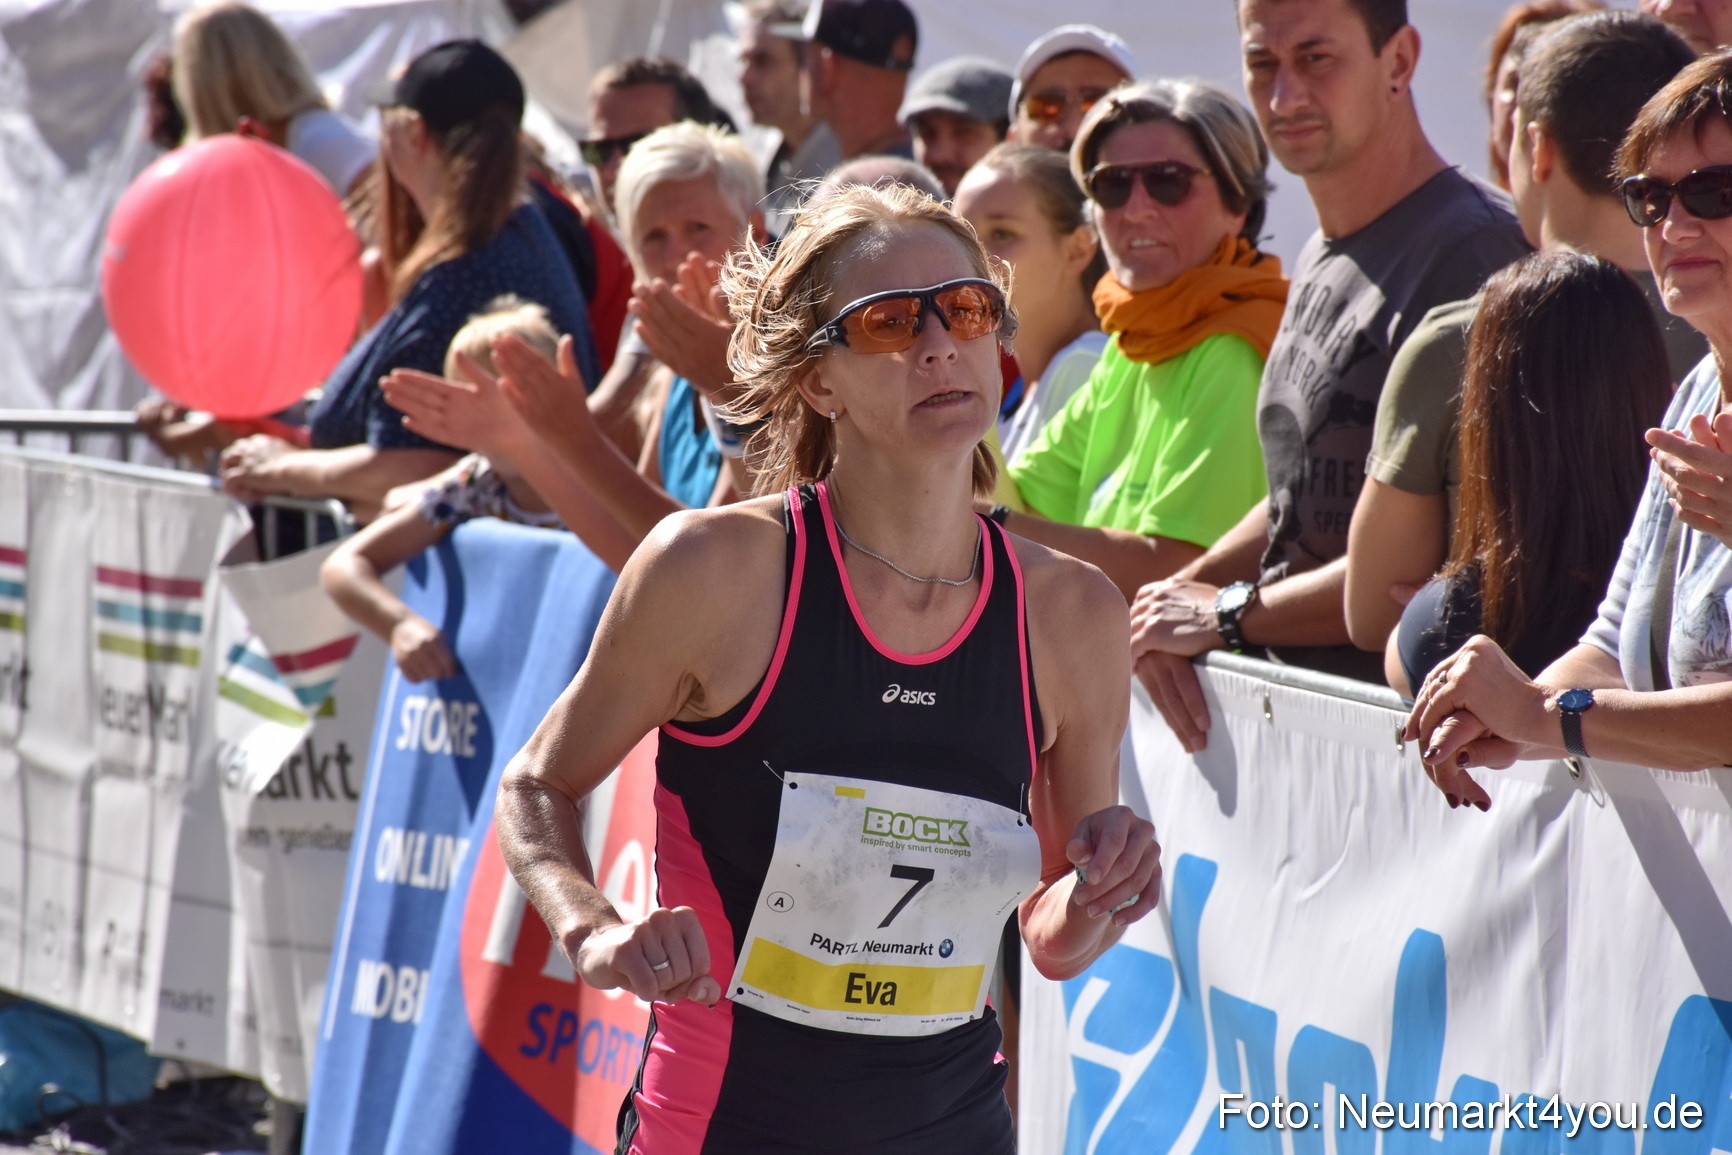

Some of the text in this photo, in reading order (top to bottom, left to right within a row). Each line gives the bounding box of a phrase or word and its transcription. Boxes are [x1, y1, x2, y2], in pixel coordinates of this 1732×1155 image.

[1309, 456, 1363, 498] FRE
[1313, 510, 1350, 535] SPE
[900, 690, 936, 706] asics
[396, 695, 478, 758] STORE
[863, 807, 971, 847] BOCK
[861, 835, 972, 858] inspired by smart concepts
[774, 897, 785, 908] A
[876, 864, 935, 929] 7
[862, 940, 934, 956] Neumarkt
[352, 958, 431, 1026] MOBI
[844, 972, 898, 1006] Eva
